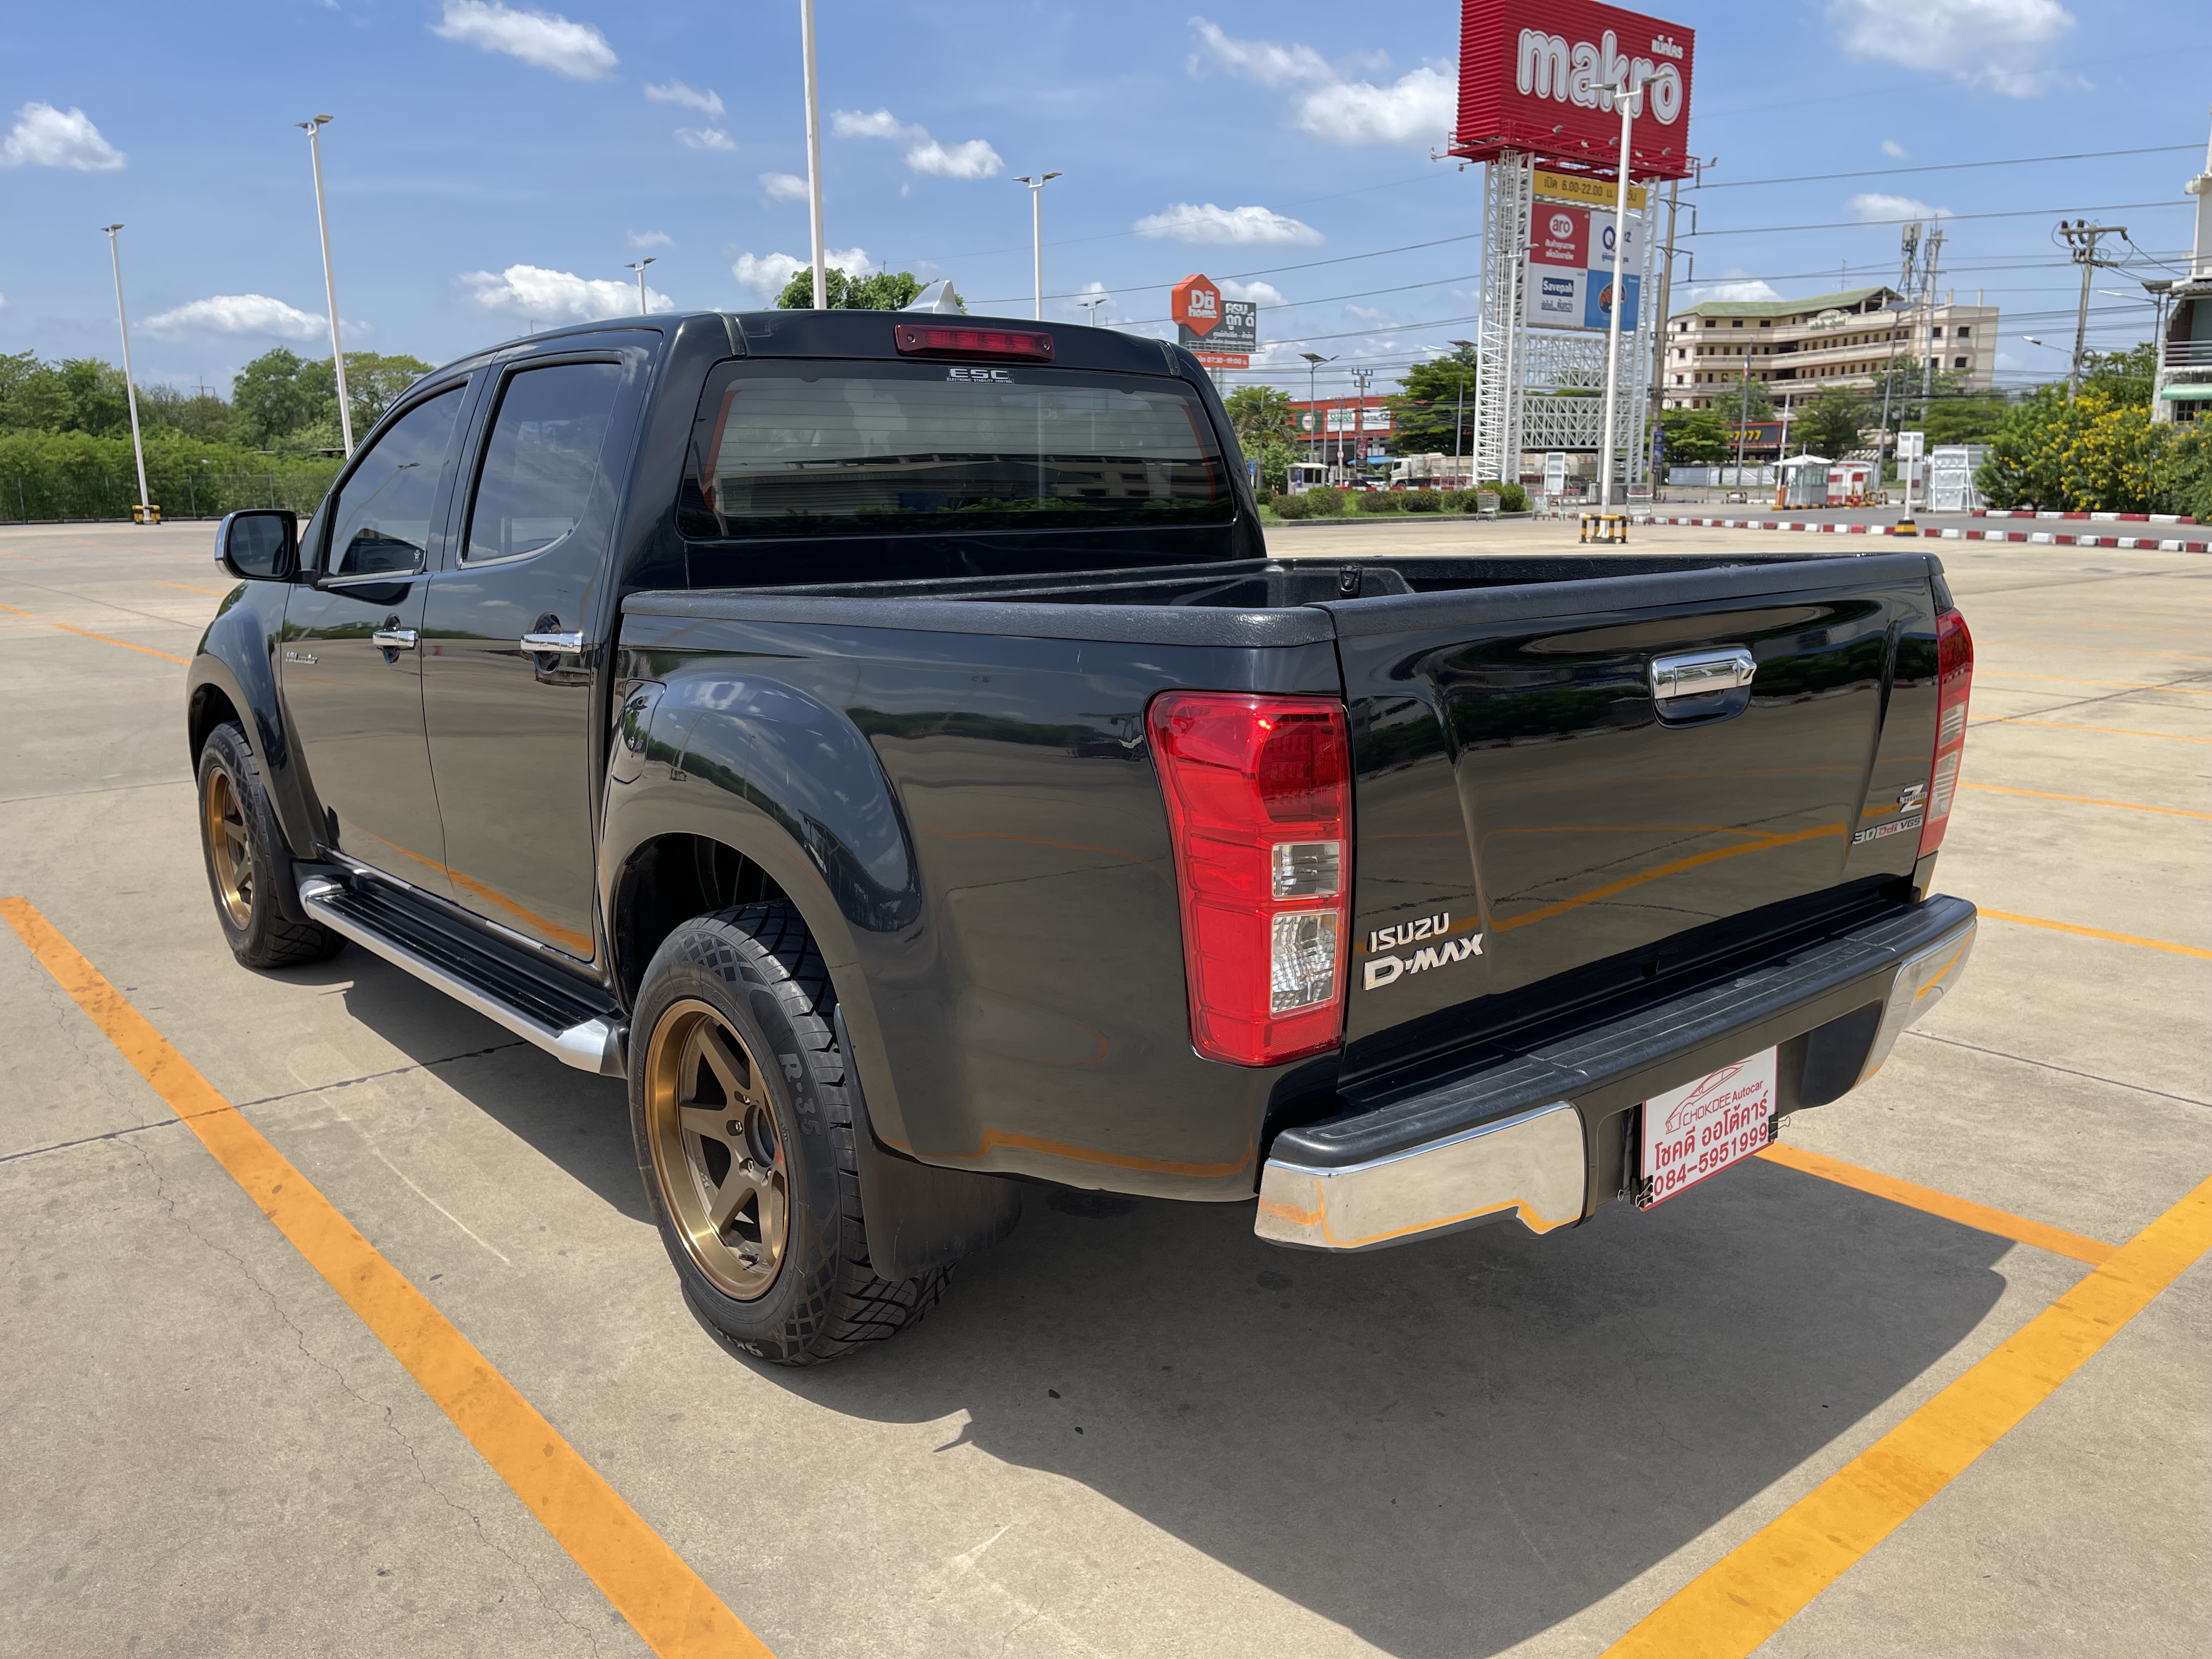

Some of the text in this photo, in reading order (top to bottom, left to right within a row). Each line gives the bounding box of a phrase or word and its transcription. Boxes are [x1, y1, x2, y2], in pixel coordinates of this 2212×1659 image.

[1516, 28, 1683, 126] makro
[1562, 180, 1603, 196] 6.00-22.00
[1553, 219, 1570, 233] aro
[1543, 280, 1573, 294] Savepak
[1188, 305, 1217, 319] home
[950, 369, 1008, 380] ESC
[1900, 783, 1924, 813] Z
[1903, 792, 1927, 804] PRESTIGE
[1878, 823, 1898, 836] Ddi
[1900, 817, 1921, 830] VGS
[1369, 912, 1449, 953] ISUZU
[1363, 932, 1483, 991] D-MAX
[1683, 1080, 1764, 1126] CHOKDEE Autocar
[1655, 1089, 1769, 1171] โชคดี ออโต้คาร์
[1653, 1122, 1768, 1197] 084-5951999
